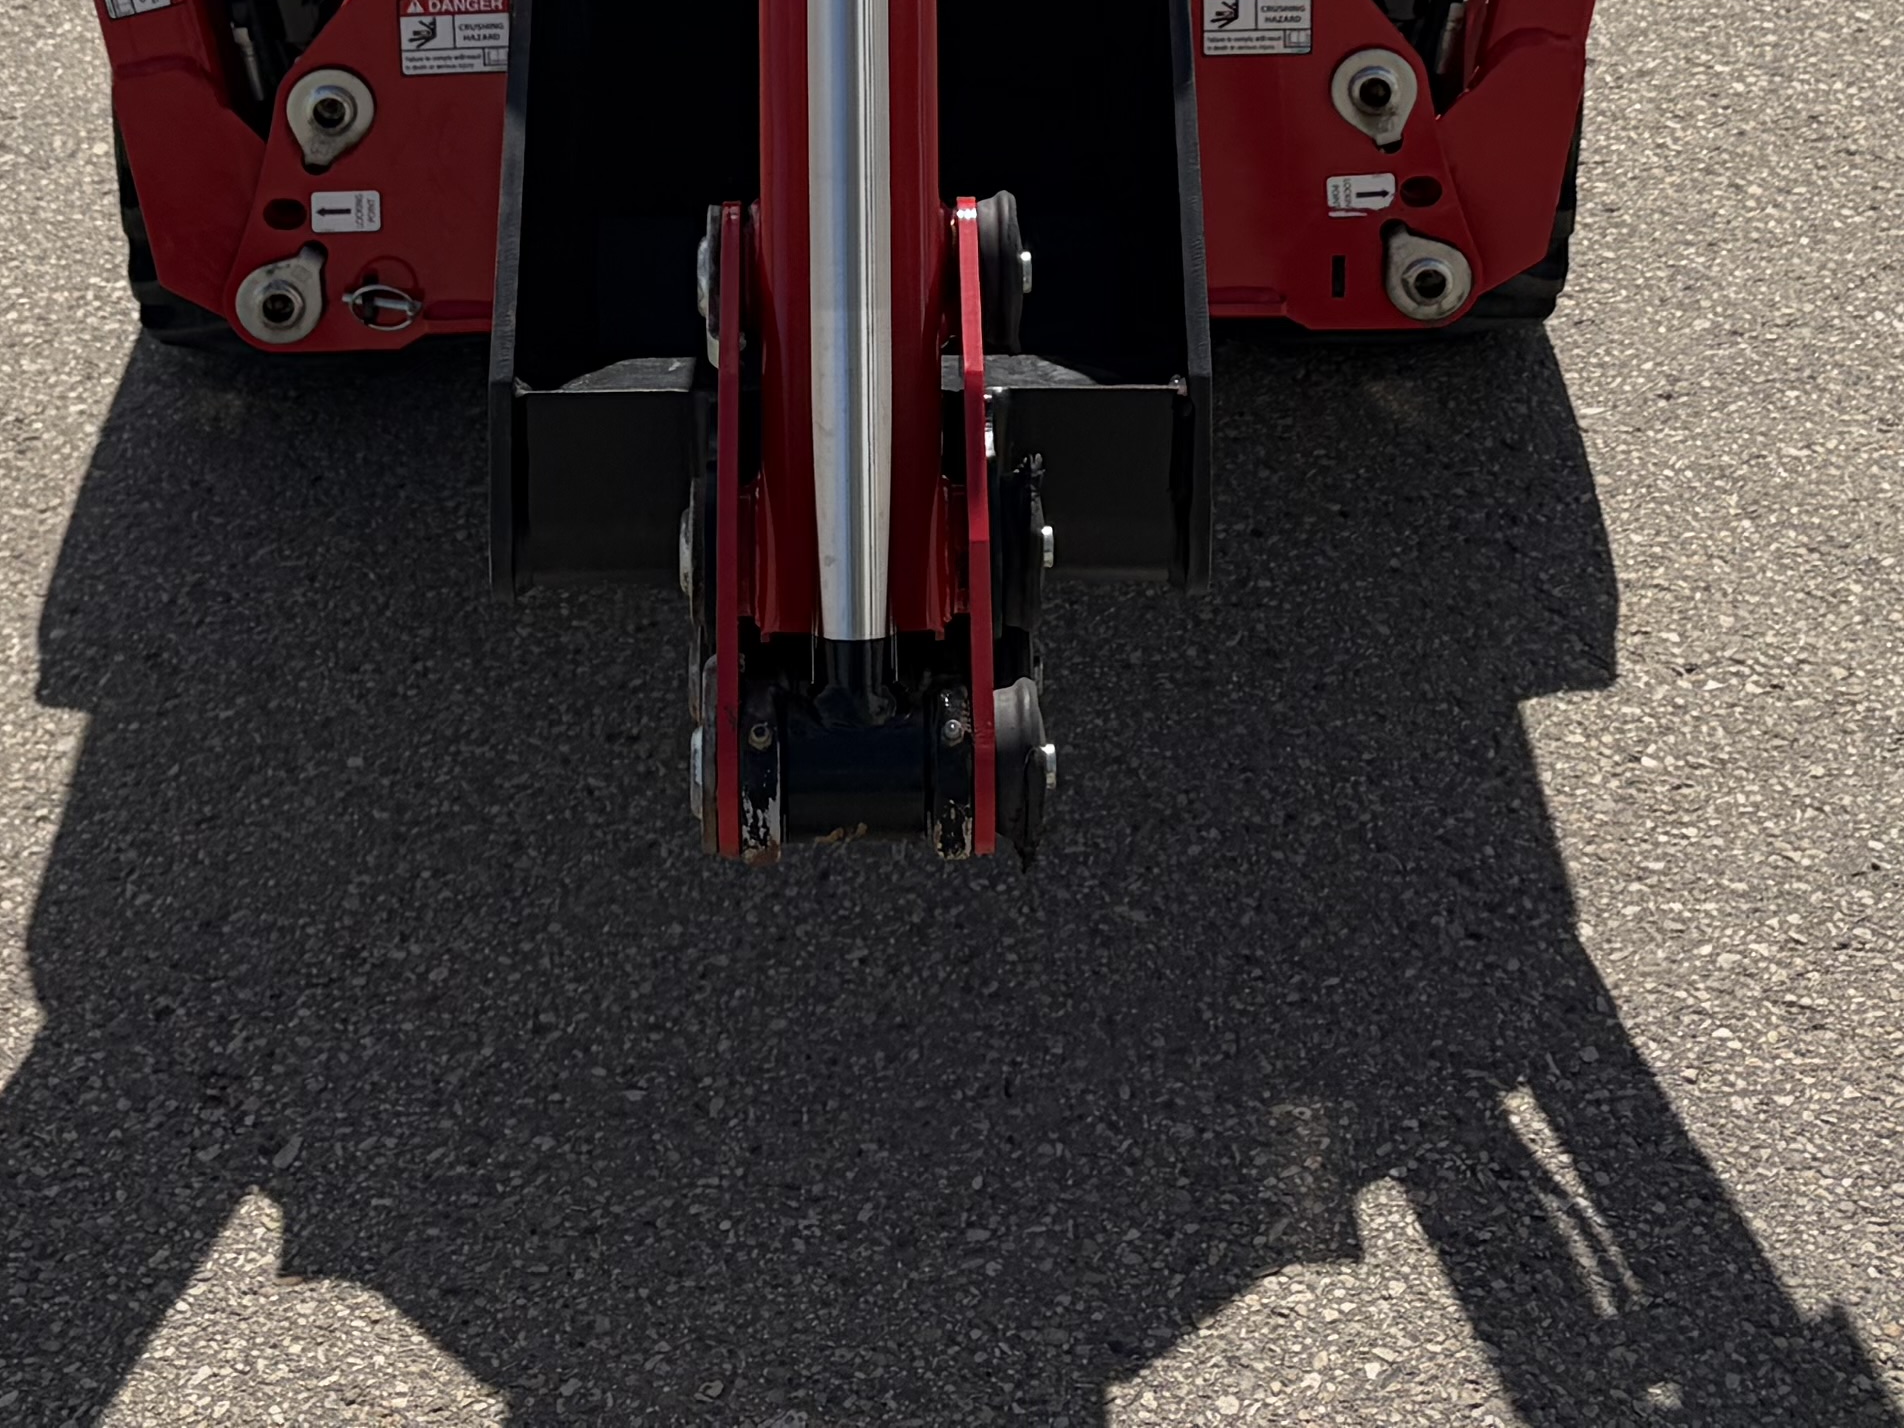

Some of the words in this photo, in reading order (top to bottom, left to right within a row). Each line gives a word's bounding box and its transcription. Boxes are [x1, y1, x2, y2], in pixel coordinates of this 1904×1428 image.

[1260, 5, 1306, 13] CRUSHING
[1264, 15, 1302, 23] HAZARD
[458, 22, 505, 31] CRUSHING
[463, 33, 501, 41] HAZARD
[355, 193, 364, 229] LOCKING
[367, 198, 376, 223] POINT
